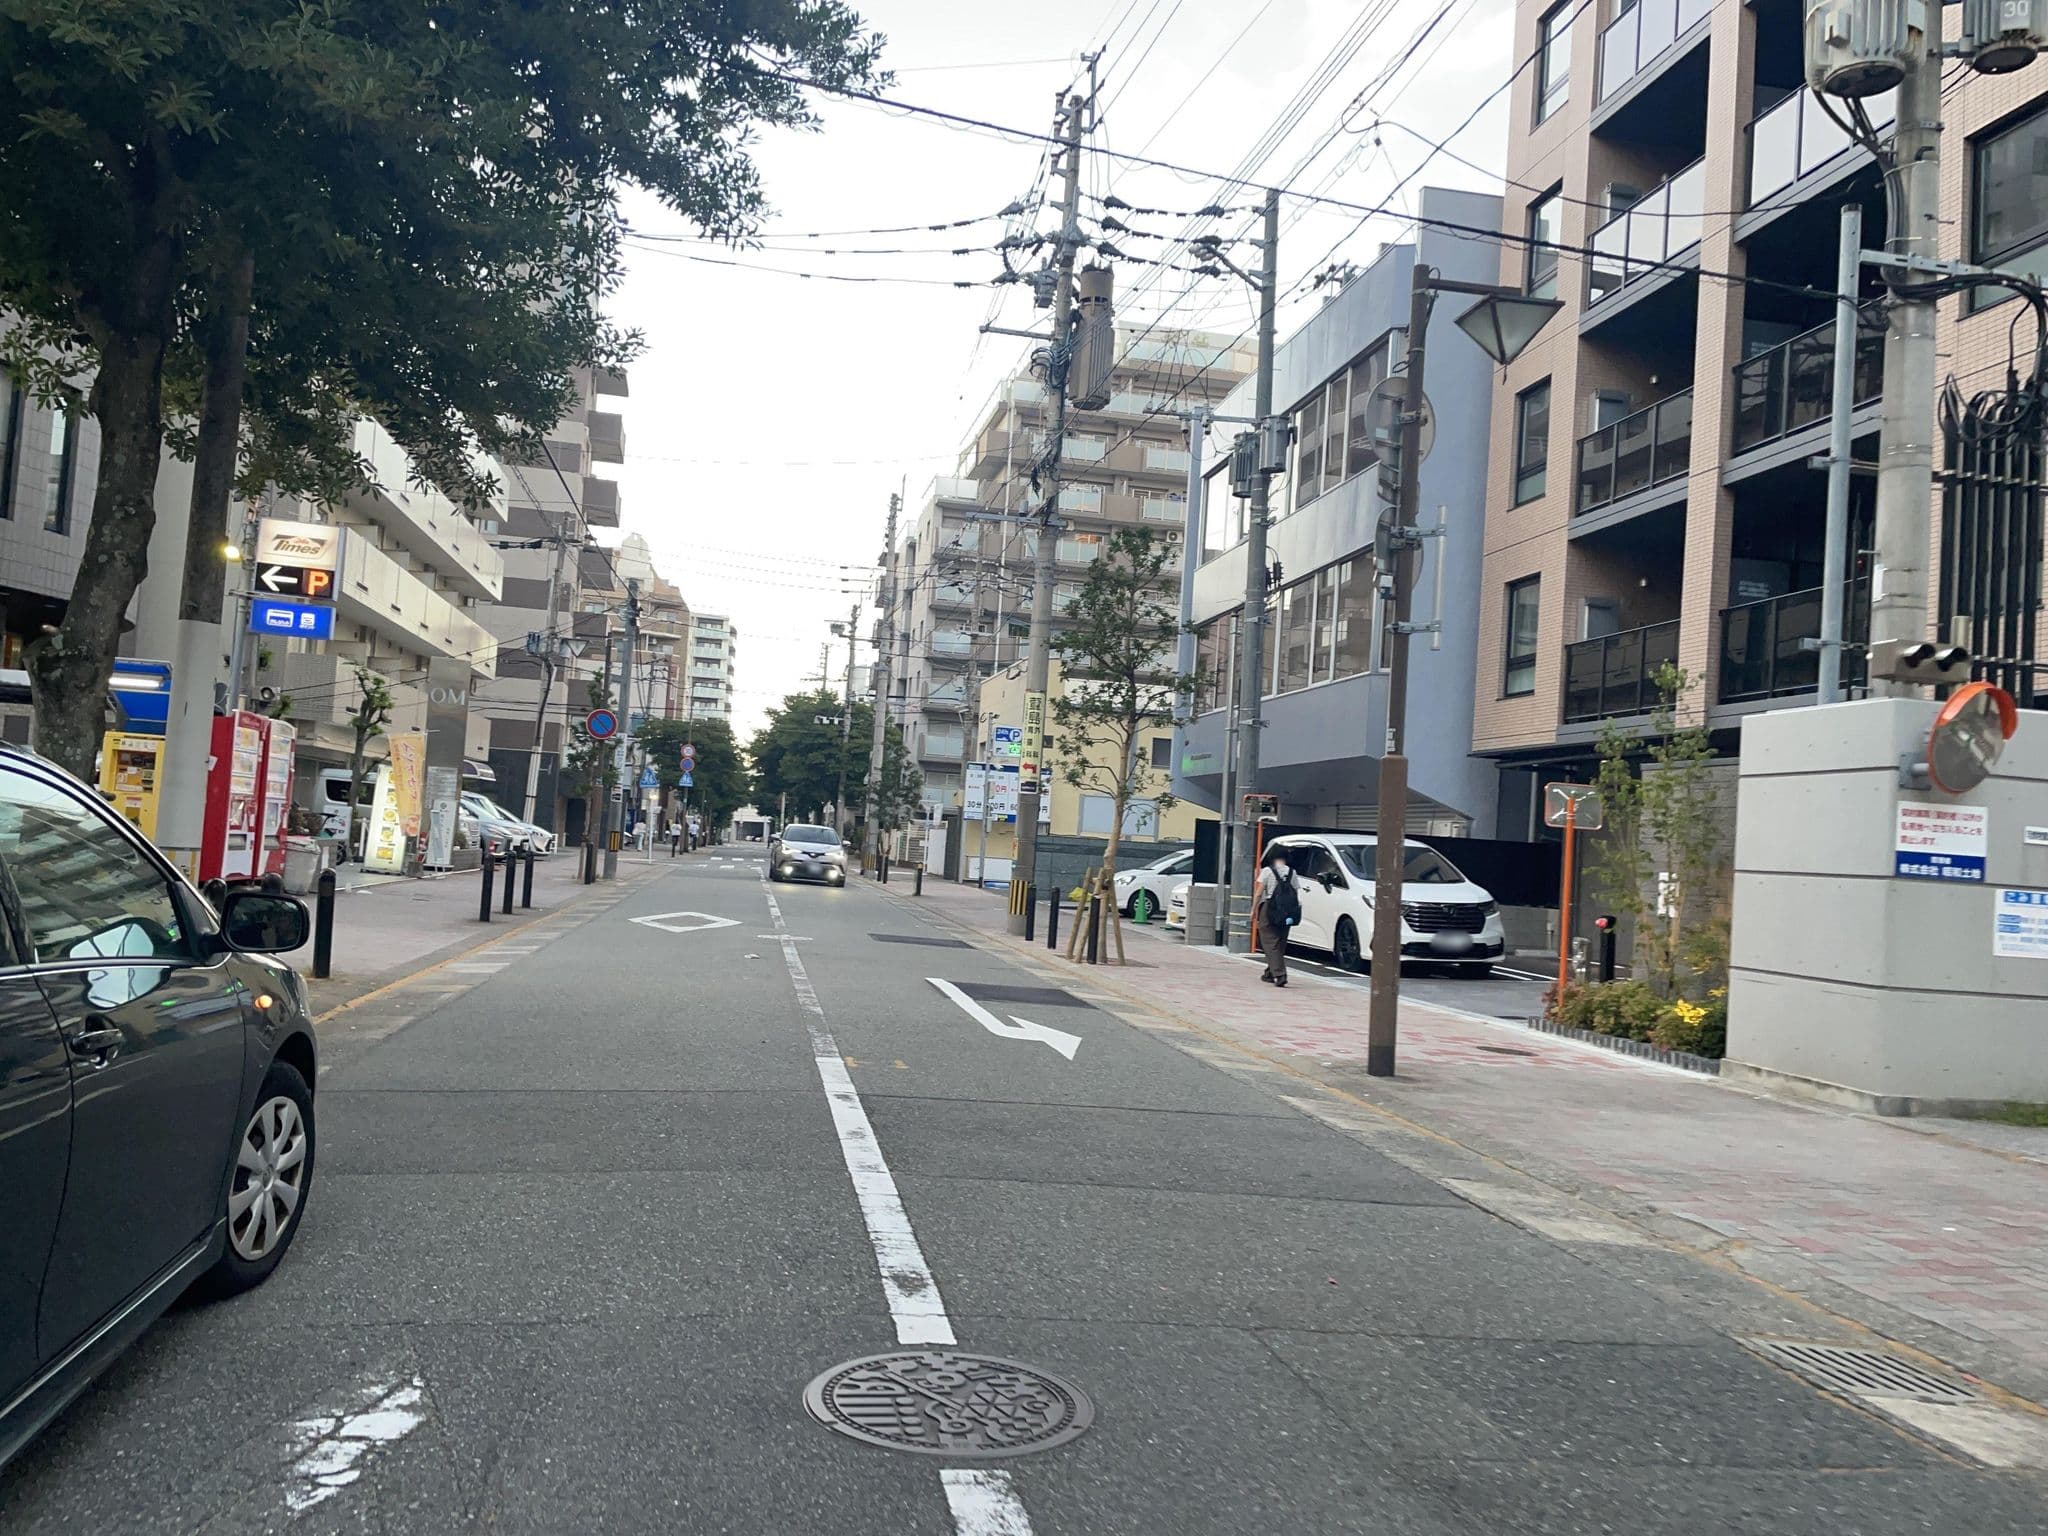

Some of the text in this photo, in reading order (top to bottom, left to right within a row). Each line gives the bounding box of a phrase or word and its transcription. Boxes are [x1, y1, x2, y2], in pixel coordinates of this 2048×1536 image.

[2004, 1, 2029, 17] 30
[273, 536, 322, 555] Times
[308, 571, 329, 595] P
[430, 688, 465, 705] OM
[1012, 730, 1020, 742] P
[1899, 863, 1939, 877] 株式会社
